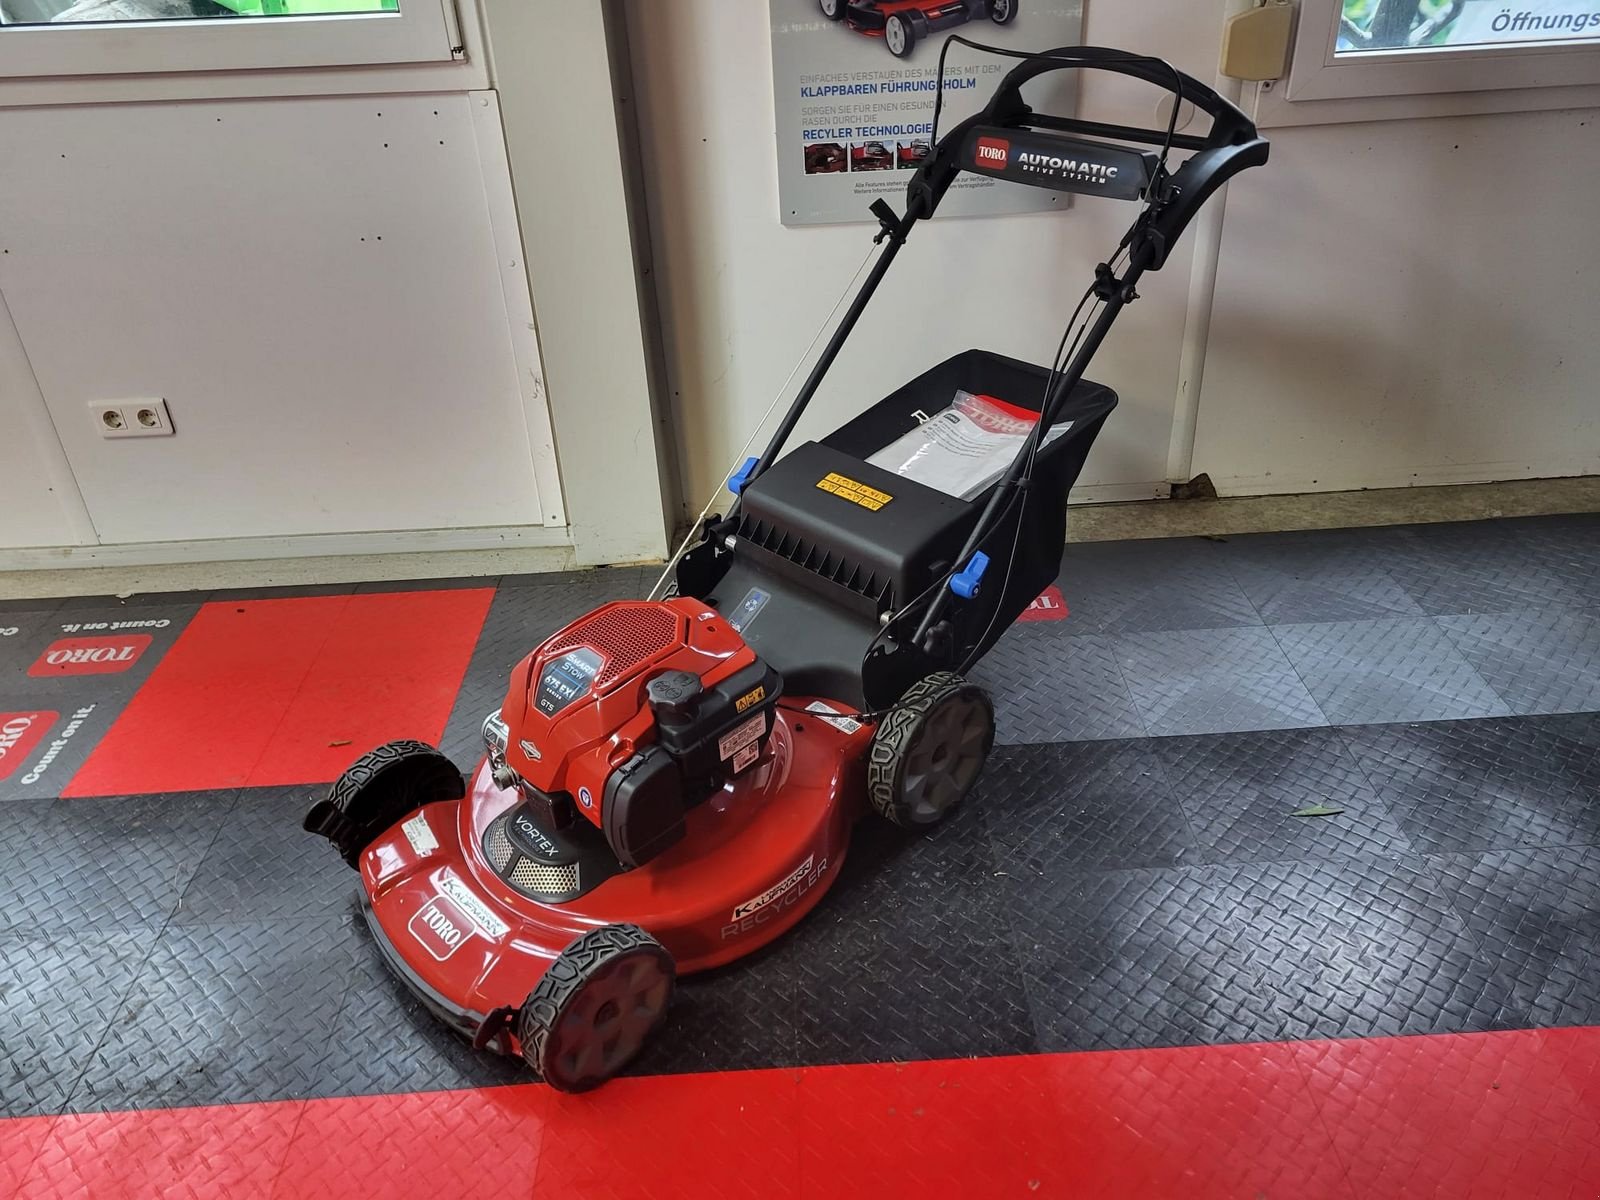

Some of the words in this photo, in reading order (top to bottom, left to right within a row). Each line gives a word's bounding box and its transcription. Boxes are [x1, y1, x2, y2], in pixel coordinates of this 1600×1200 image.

[1491, 8, 1600, 32] Öffnungs
[800, 72, 849, 84] EINFACHES
[850, 69, 902, 82] VERSTAUEN
[904, 69, 922, 79] DES
[924, 66, 962, 77] MÄERS
[964, 65, 980, 75] MIT
[982, 64, 1002, 74] DEM
[800, 82, 877, 98] KLAPPBAREN
[880, 78, 976, 95] FÜHRUNGHOLM
[802, 105, 837, 116] SORGEN
[838, 104, 852, 114] SIE
[873, 102, 898, 112] EINEN
[900, 99, 946, 110] GESUNDN
[802, 116, 831, 126] RASEN
[833, 115, 861, 124] DURCH
[863, 114, 877, 123] DIE
[803, 127, 853, 140] RECYLER
[855, 123, 932, 137] TECHNOLOGIE
[979, 146, 1006, 161] TORO
[1018, 152, 1118, 178] AUTOMATIC
[1022, 164, 1054, 175] DRIVE
[1062, 171, 1106, 184] SYSTEM
[83, 622, 108, 630] on
[110, 619, 171, 630] Count
[46, 646, 136, 665] TORO
[566, 653, 595, 675] SMART
[562, 662, 585, 680] STOW
[540, 699, 555, 712] GTS
[21, 739, 68, 784] Count
[61, 720, 84, 738] on
[516, 815, 559, 857] VORTEX
[721, 858, 827, 940] RECYCLER
[422, 905, 461, 946] TORO
